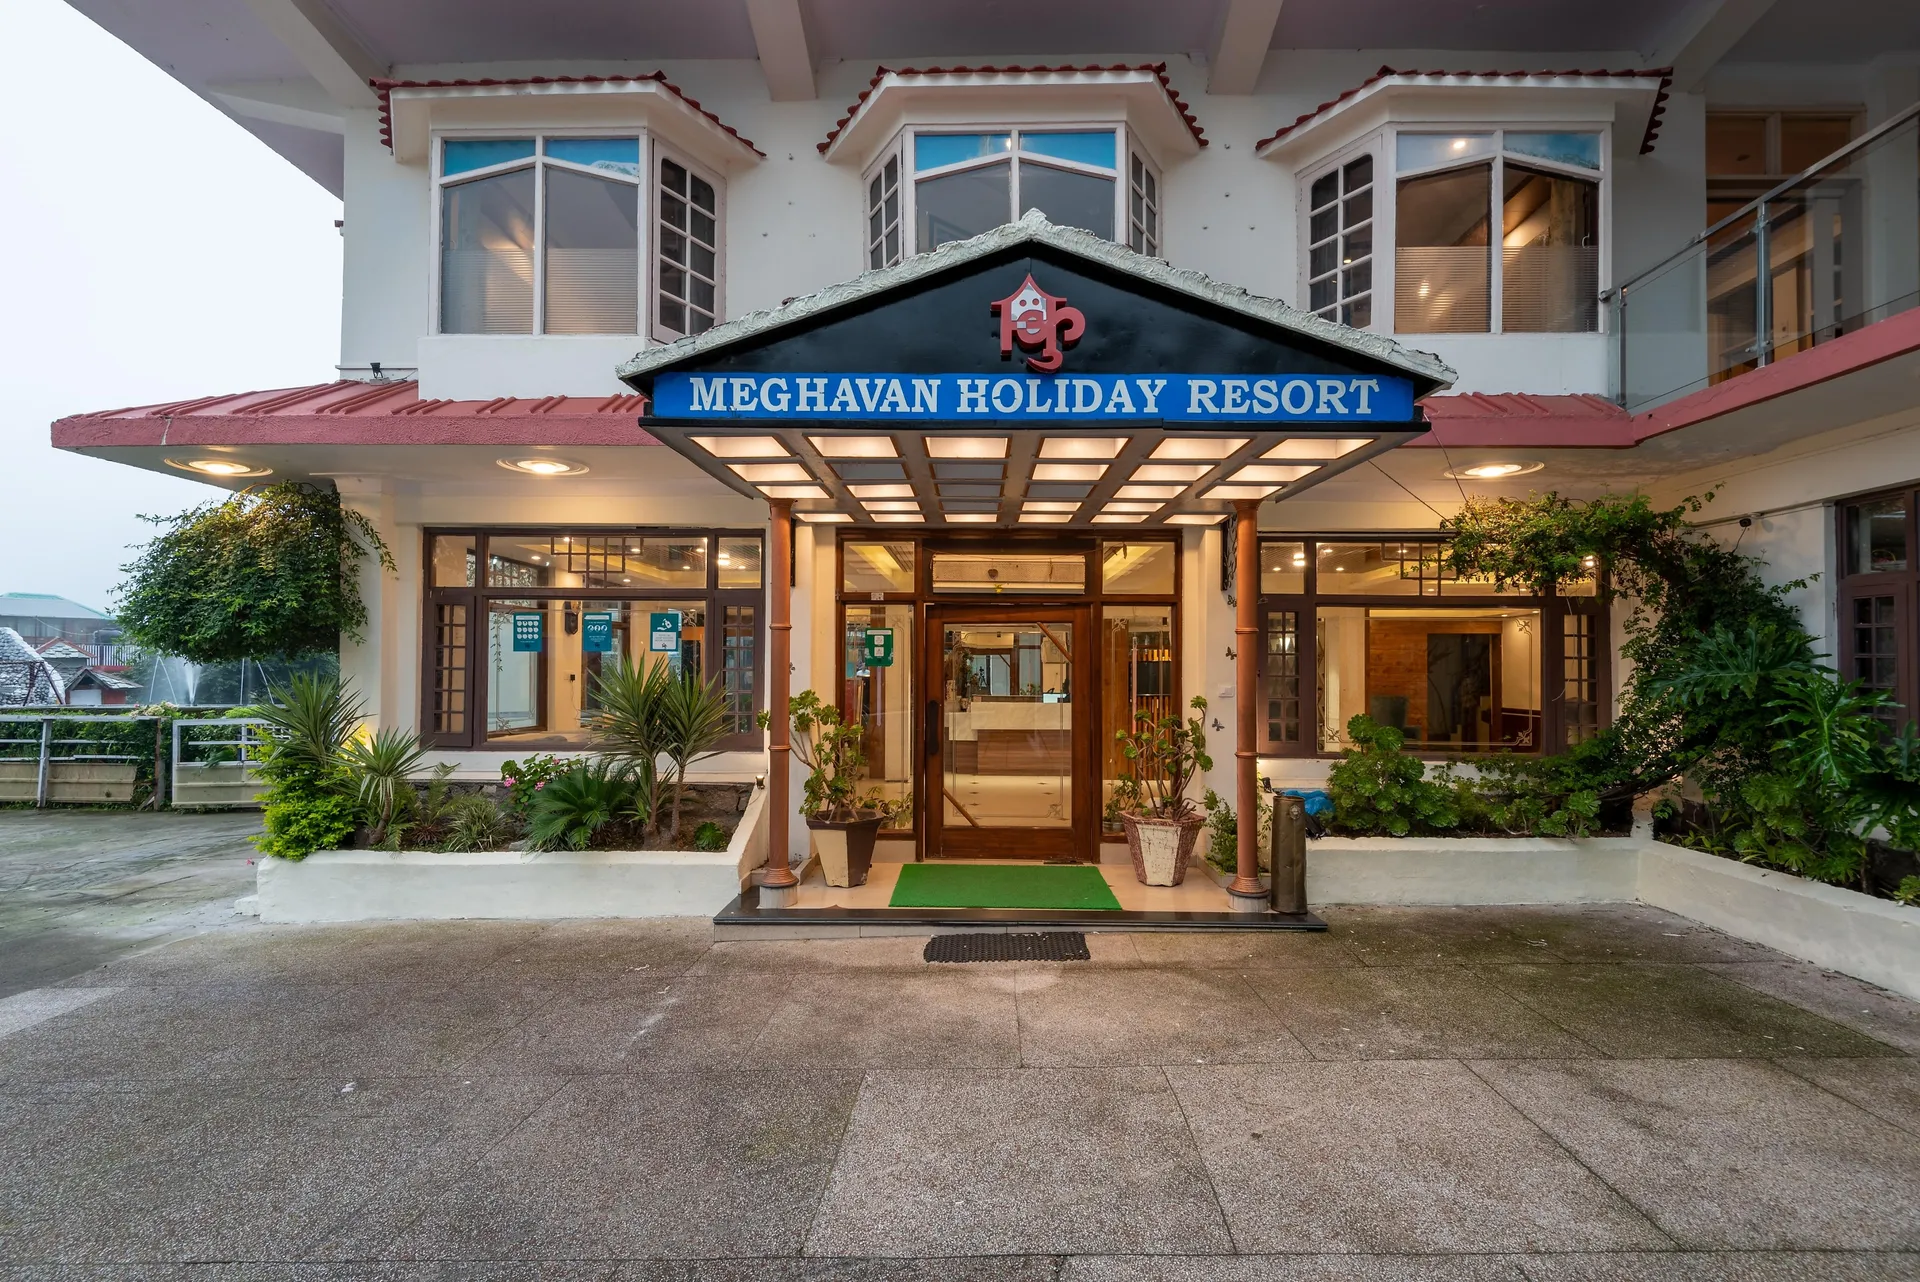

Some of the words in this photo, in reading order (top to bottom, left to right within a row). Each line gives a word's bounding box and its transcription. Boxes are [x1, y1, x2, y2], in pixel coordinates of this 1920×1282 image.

[690, 377, 941, 412] MEGHAVAN
[957, 379, 1167, 413] HOLIDAY
[1187, 379, 1377, 414] RESORT
